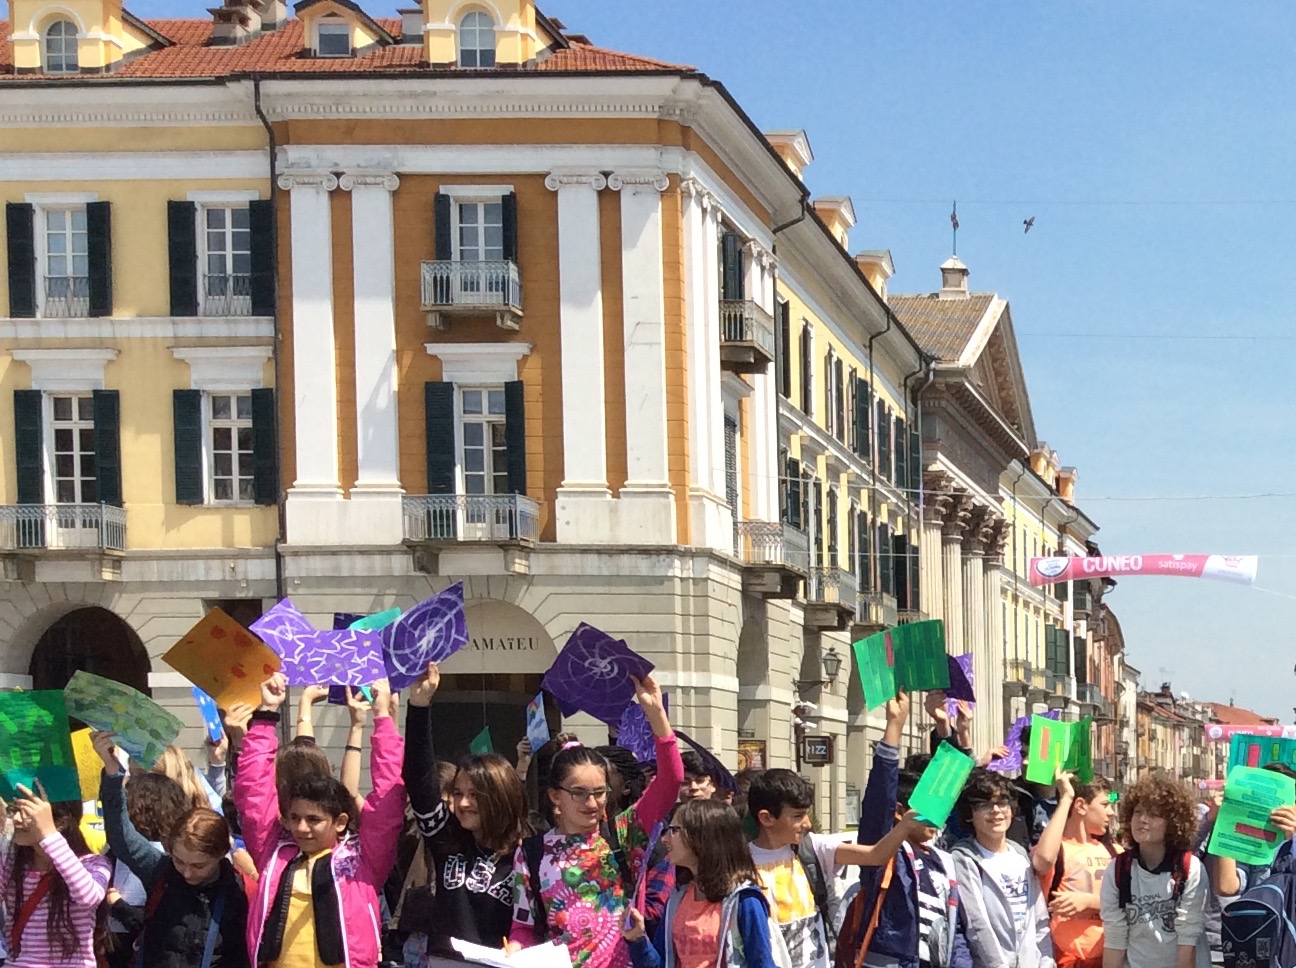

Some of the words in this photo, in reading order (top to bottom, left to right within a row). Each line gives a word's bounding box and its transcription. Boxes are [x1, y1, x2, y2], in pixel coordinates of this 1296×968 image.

[1083, 555, 1143, 573] CUNEO
[1158, 559, 1199, 572] satispay
[461, 637, 540, 651] AMAïEU
